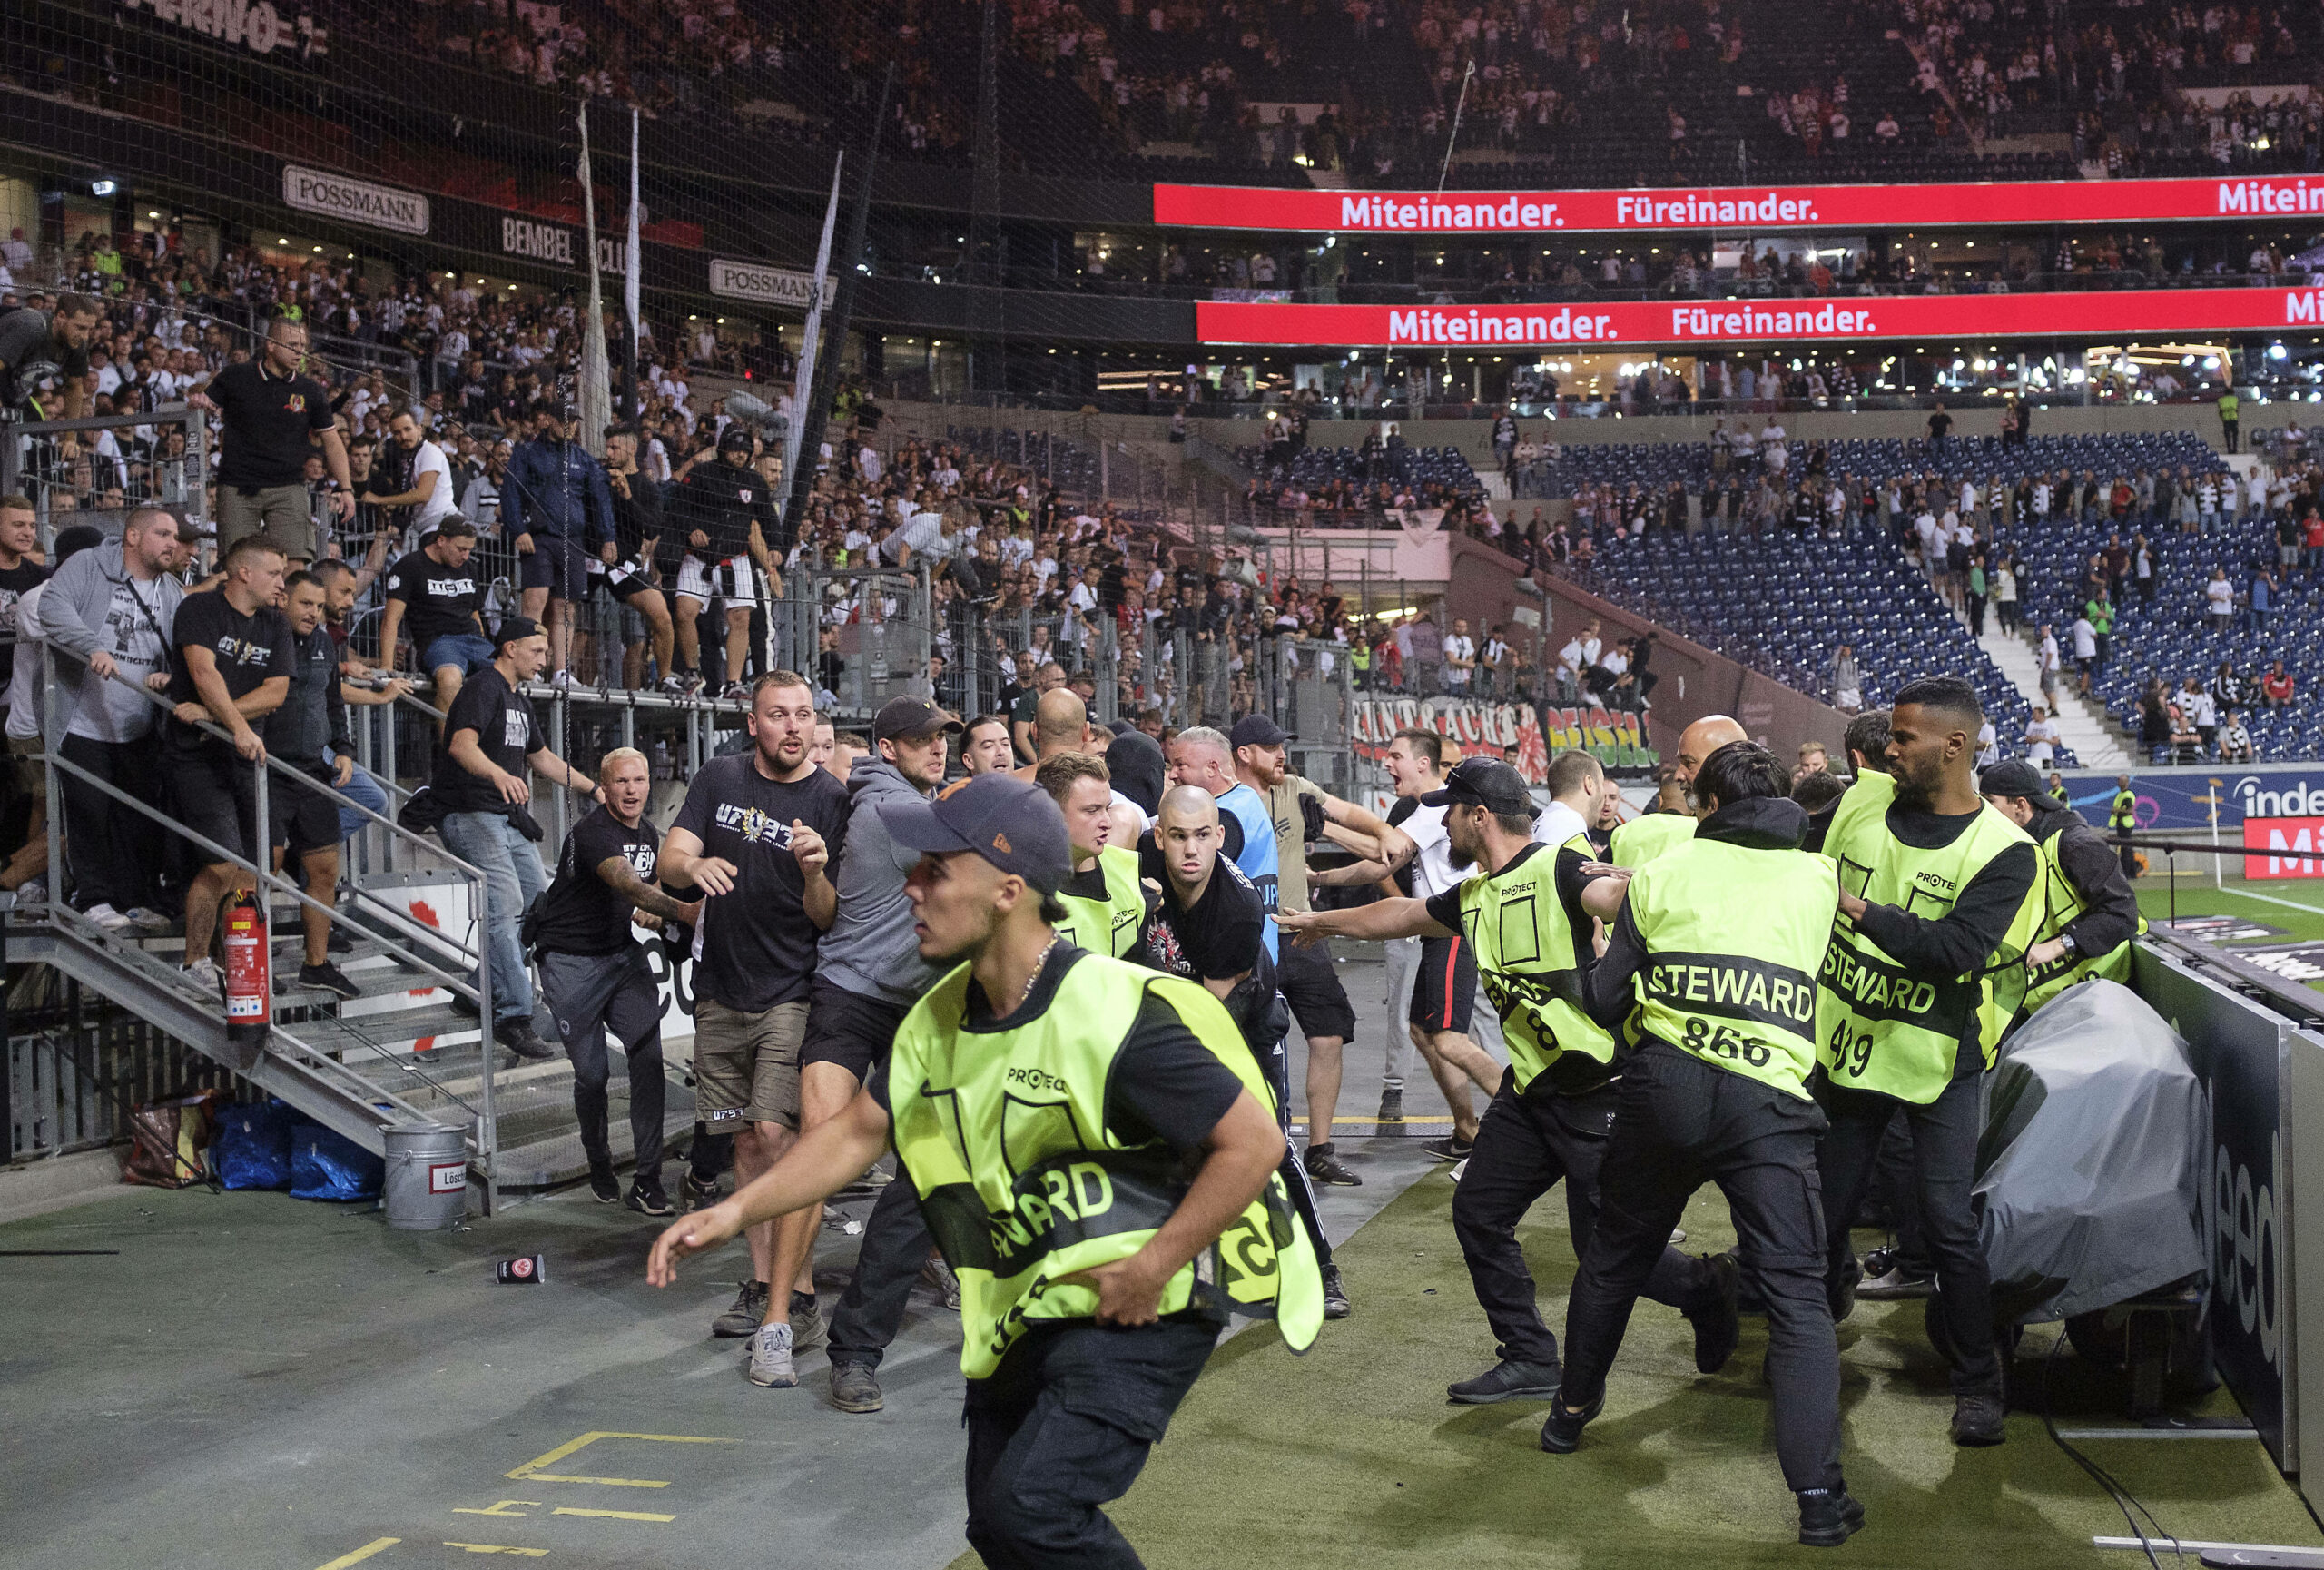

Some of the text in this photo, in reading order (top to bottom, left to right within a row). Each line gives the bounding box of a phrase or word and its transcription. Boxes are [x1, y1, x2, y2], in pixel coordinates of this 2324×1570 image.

[299, 178, 417, 224] POSSMANN
[1341, 195, 1565, 228] Miteinander.
[1616, 193, 1819, 224] Füreinander.
[502, 216, 576, 265] BEMBEL
[1389, 307, 1618, 341] Miteinander.
[1671, 302, 1876, 336] Füreinander.
[1352, 697, 1519, 747] EINTRACHT
[2243, 780, 2324, 818] inde
[1501, 881, 1537, 897] PROTECT
[1647, 963, 1814, 1023] STEWARD
[1680, 1016, 1771, 1068] 866
